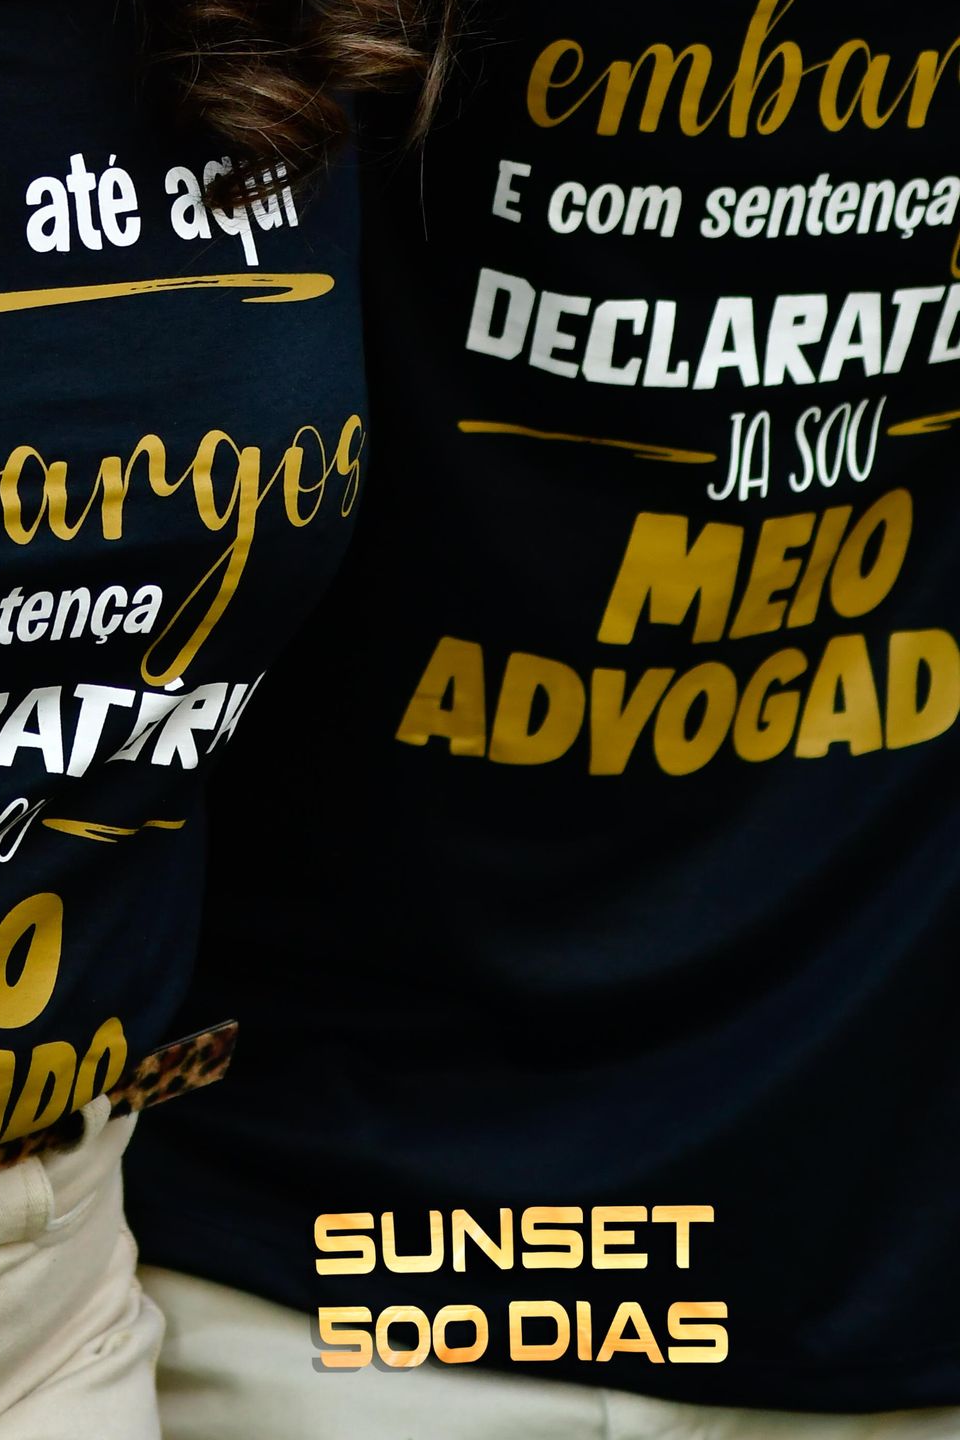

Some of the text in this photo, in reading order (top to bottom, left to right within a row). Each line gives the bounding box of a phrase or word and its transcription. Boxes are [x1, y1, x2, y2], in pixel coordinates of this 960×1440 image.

[25, 152, 141, 253] até
[492, 159, 960, 240] E com sentença
[707, 396, 887, 501] JA SOU
[597, 488, 912, 645] MEIO
[396, 628, 960, 776] ADVOGAD
